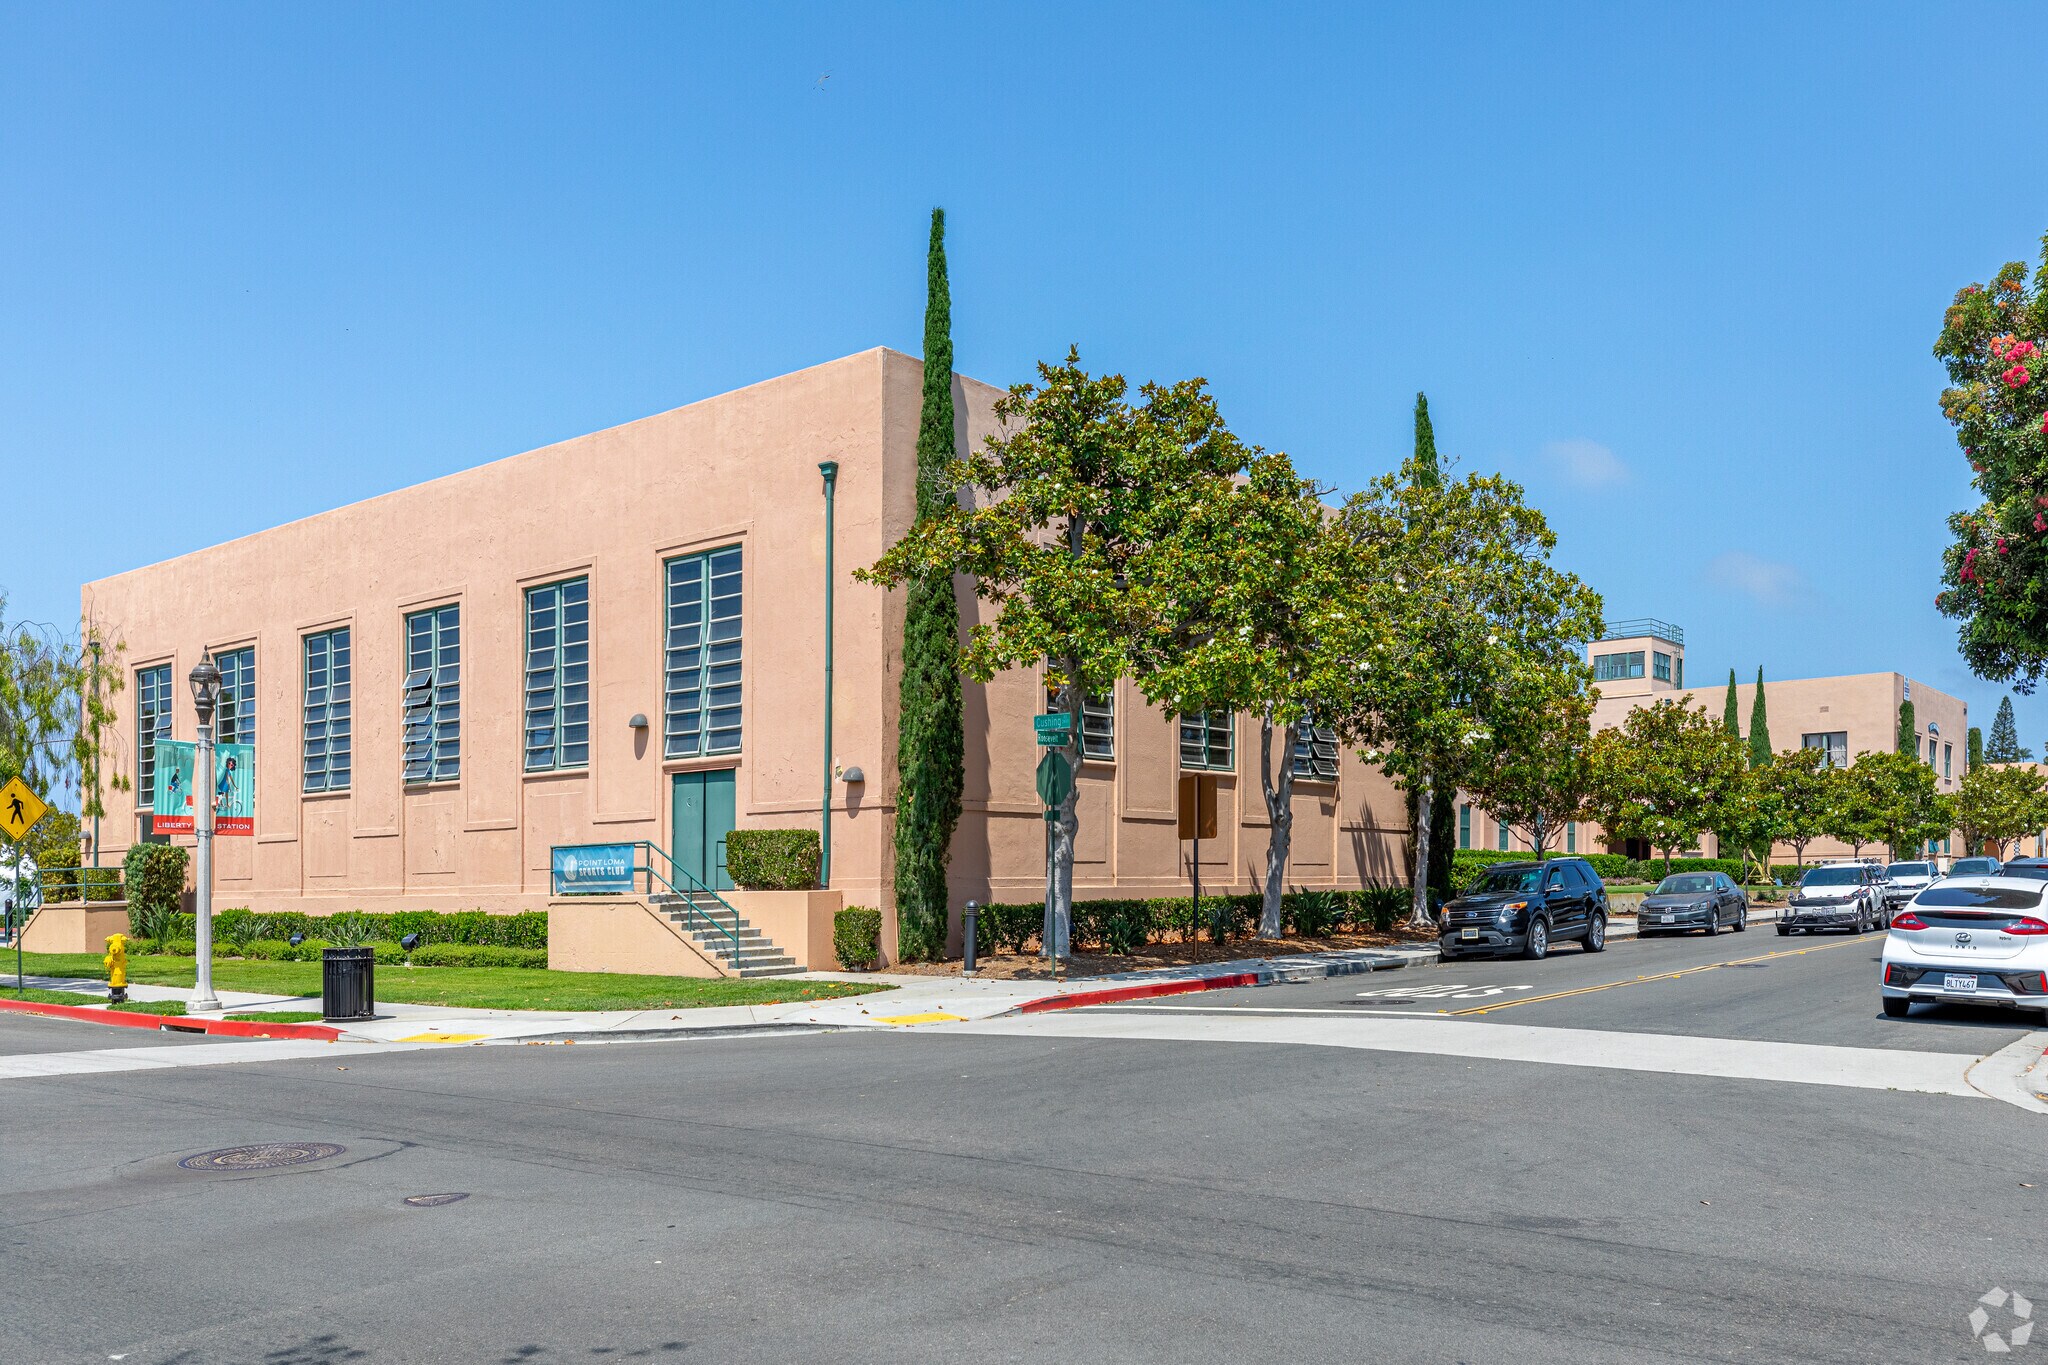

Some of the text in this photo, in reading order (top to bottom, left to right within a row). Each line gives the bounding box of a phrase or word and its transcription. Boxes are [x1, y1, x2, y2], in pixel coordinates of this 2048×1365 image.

[1036, 716, 1061, 728] Cushing
[578, 859, 602, 867] POINT
[579, 866, 625, 876] SPORTS CLUB
[1946, 979, 1975, 989] 8LTY467
[1356, 984, 1534, 998] STOP
